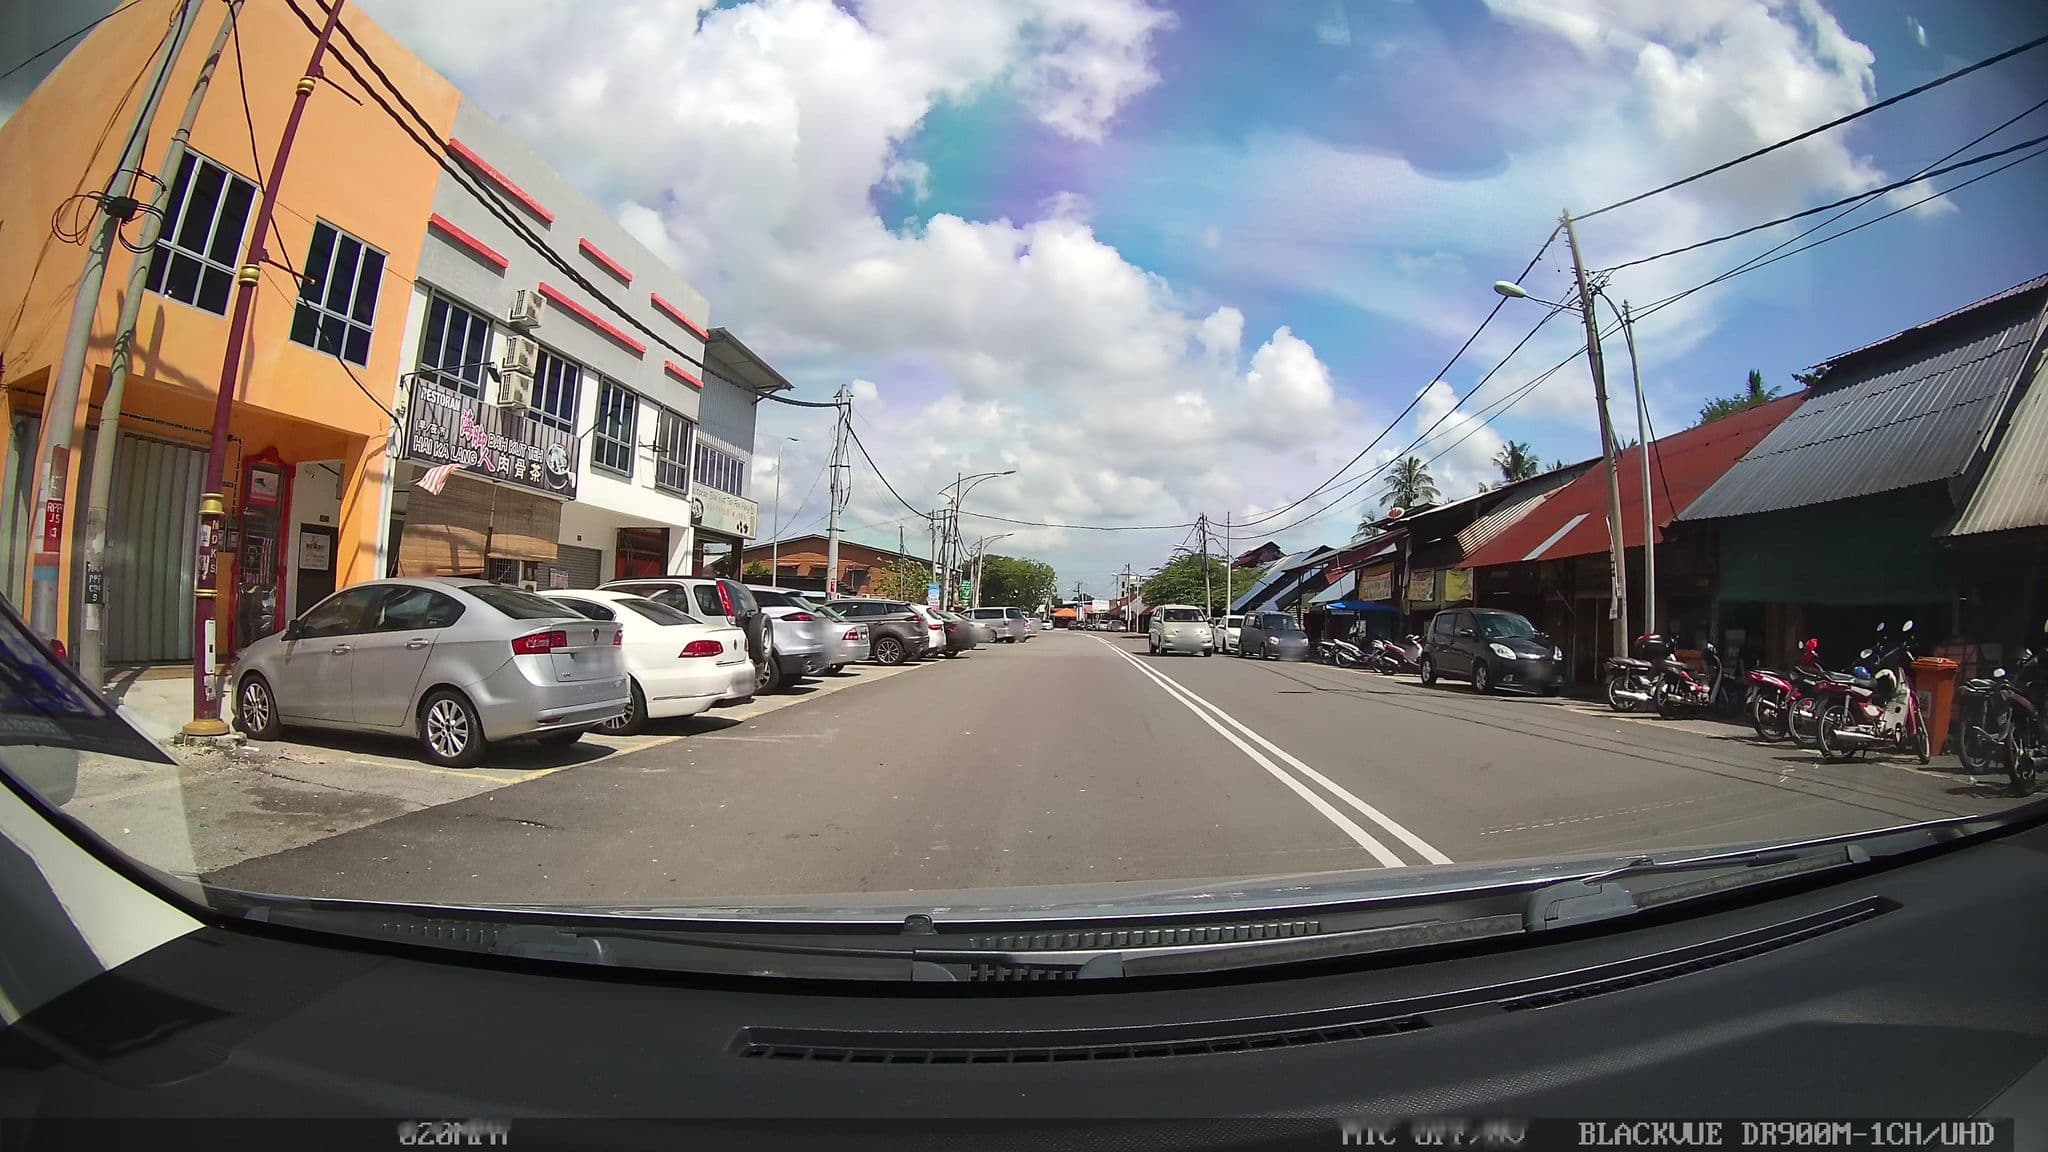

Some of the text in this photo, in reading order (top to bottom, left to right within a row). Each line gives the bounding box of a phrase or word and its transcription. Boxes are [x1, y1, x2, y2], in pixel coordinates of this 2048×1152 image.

[421, 387, 461, 411] RESTORAN
[413, 434, 478, 466] HAI KA LANG
[488, 433, 544, 464] BAH KUT TEH
[496, 452, 542, 483] 肉骨茶
